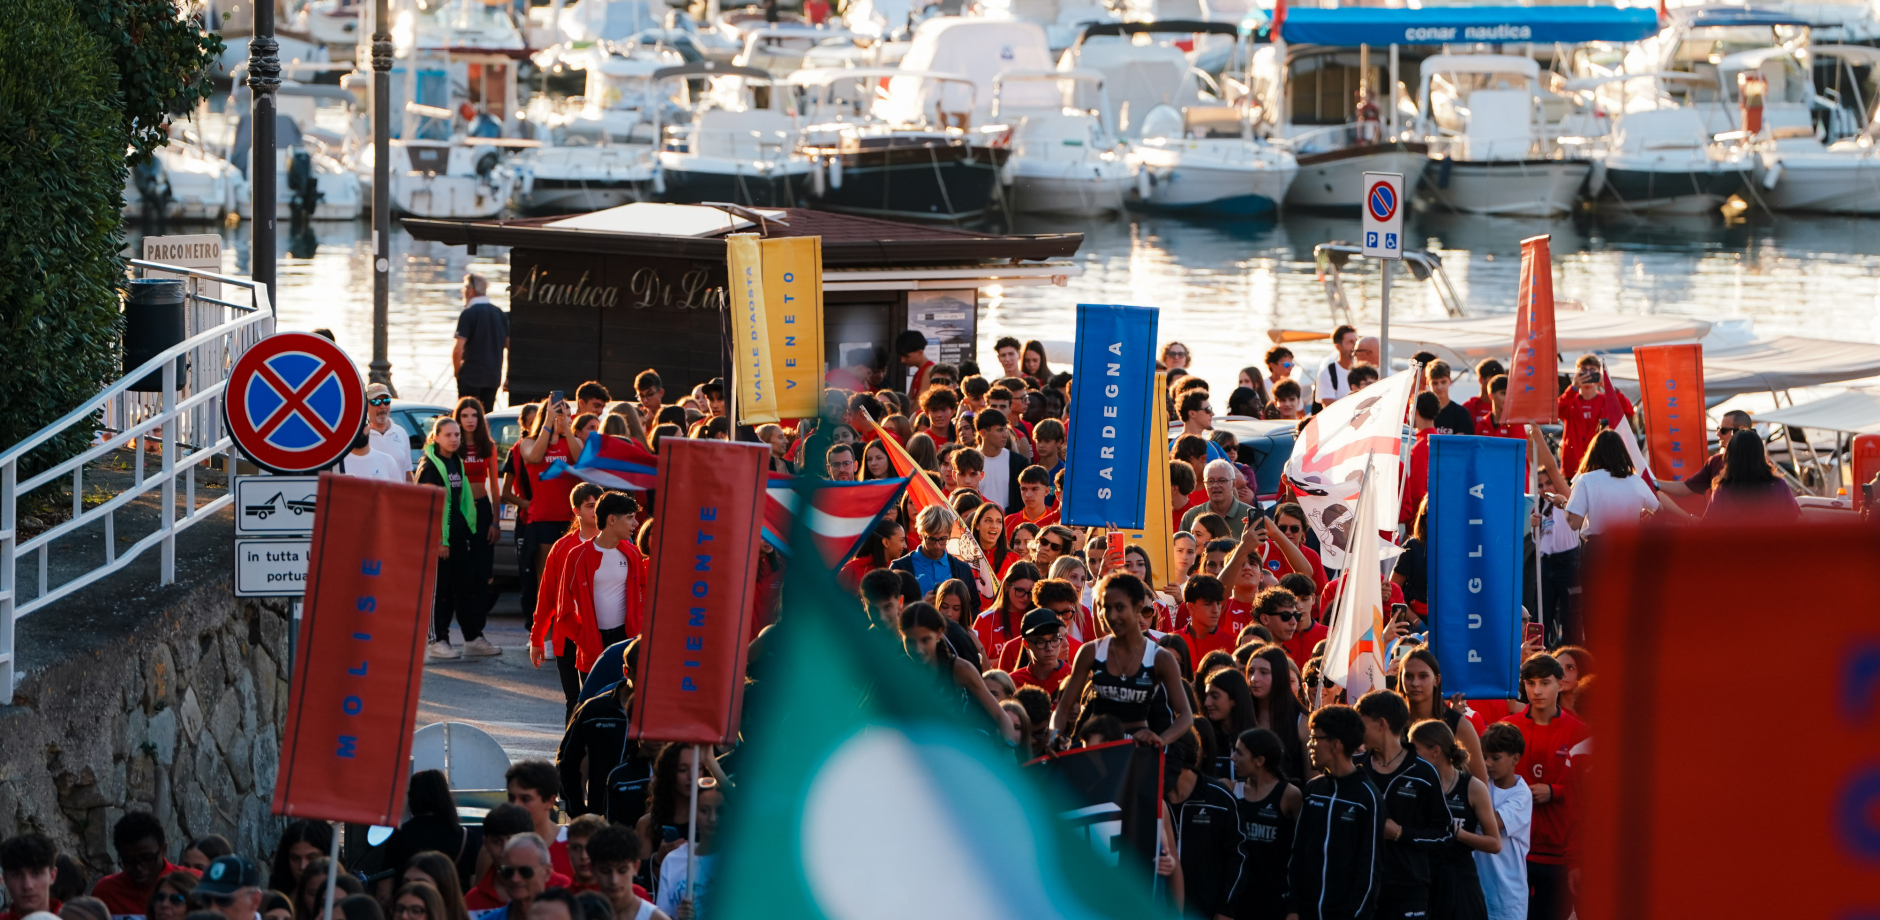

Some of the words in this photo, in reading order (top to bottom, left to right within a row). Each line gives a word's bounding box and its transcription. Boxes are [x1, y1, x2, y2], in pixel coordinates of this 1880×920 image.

[1404, 26, 1458, 41] conar
[1464, 23, 1532, 40] nautica
[147, 243, 219, 260] PARCOMETRO
[511, 264, 619, 308] Nautica
[745, 266, 758, 341] D'AOSTA
[783, 272, 797, 390] VENETO
[752, 347, 762, 402] VALLE
[1097, 342, 1122, 500] SARDEGNA
[1665, 379, 1684, 485] RENTINO
[247, 551, 260, 562] in
[266, 551, 299, 562] tutta
[681, 506, 718, 692] PIEMONTE
[1467, 483, 1485, 663] PUGLIA
[336, 558, 382, 759] MOLISE
